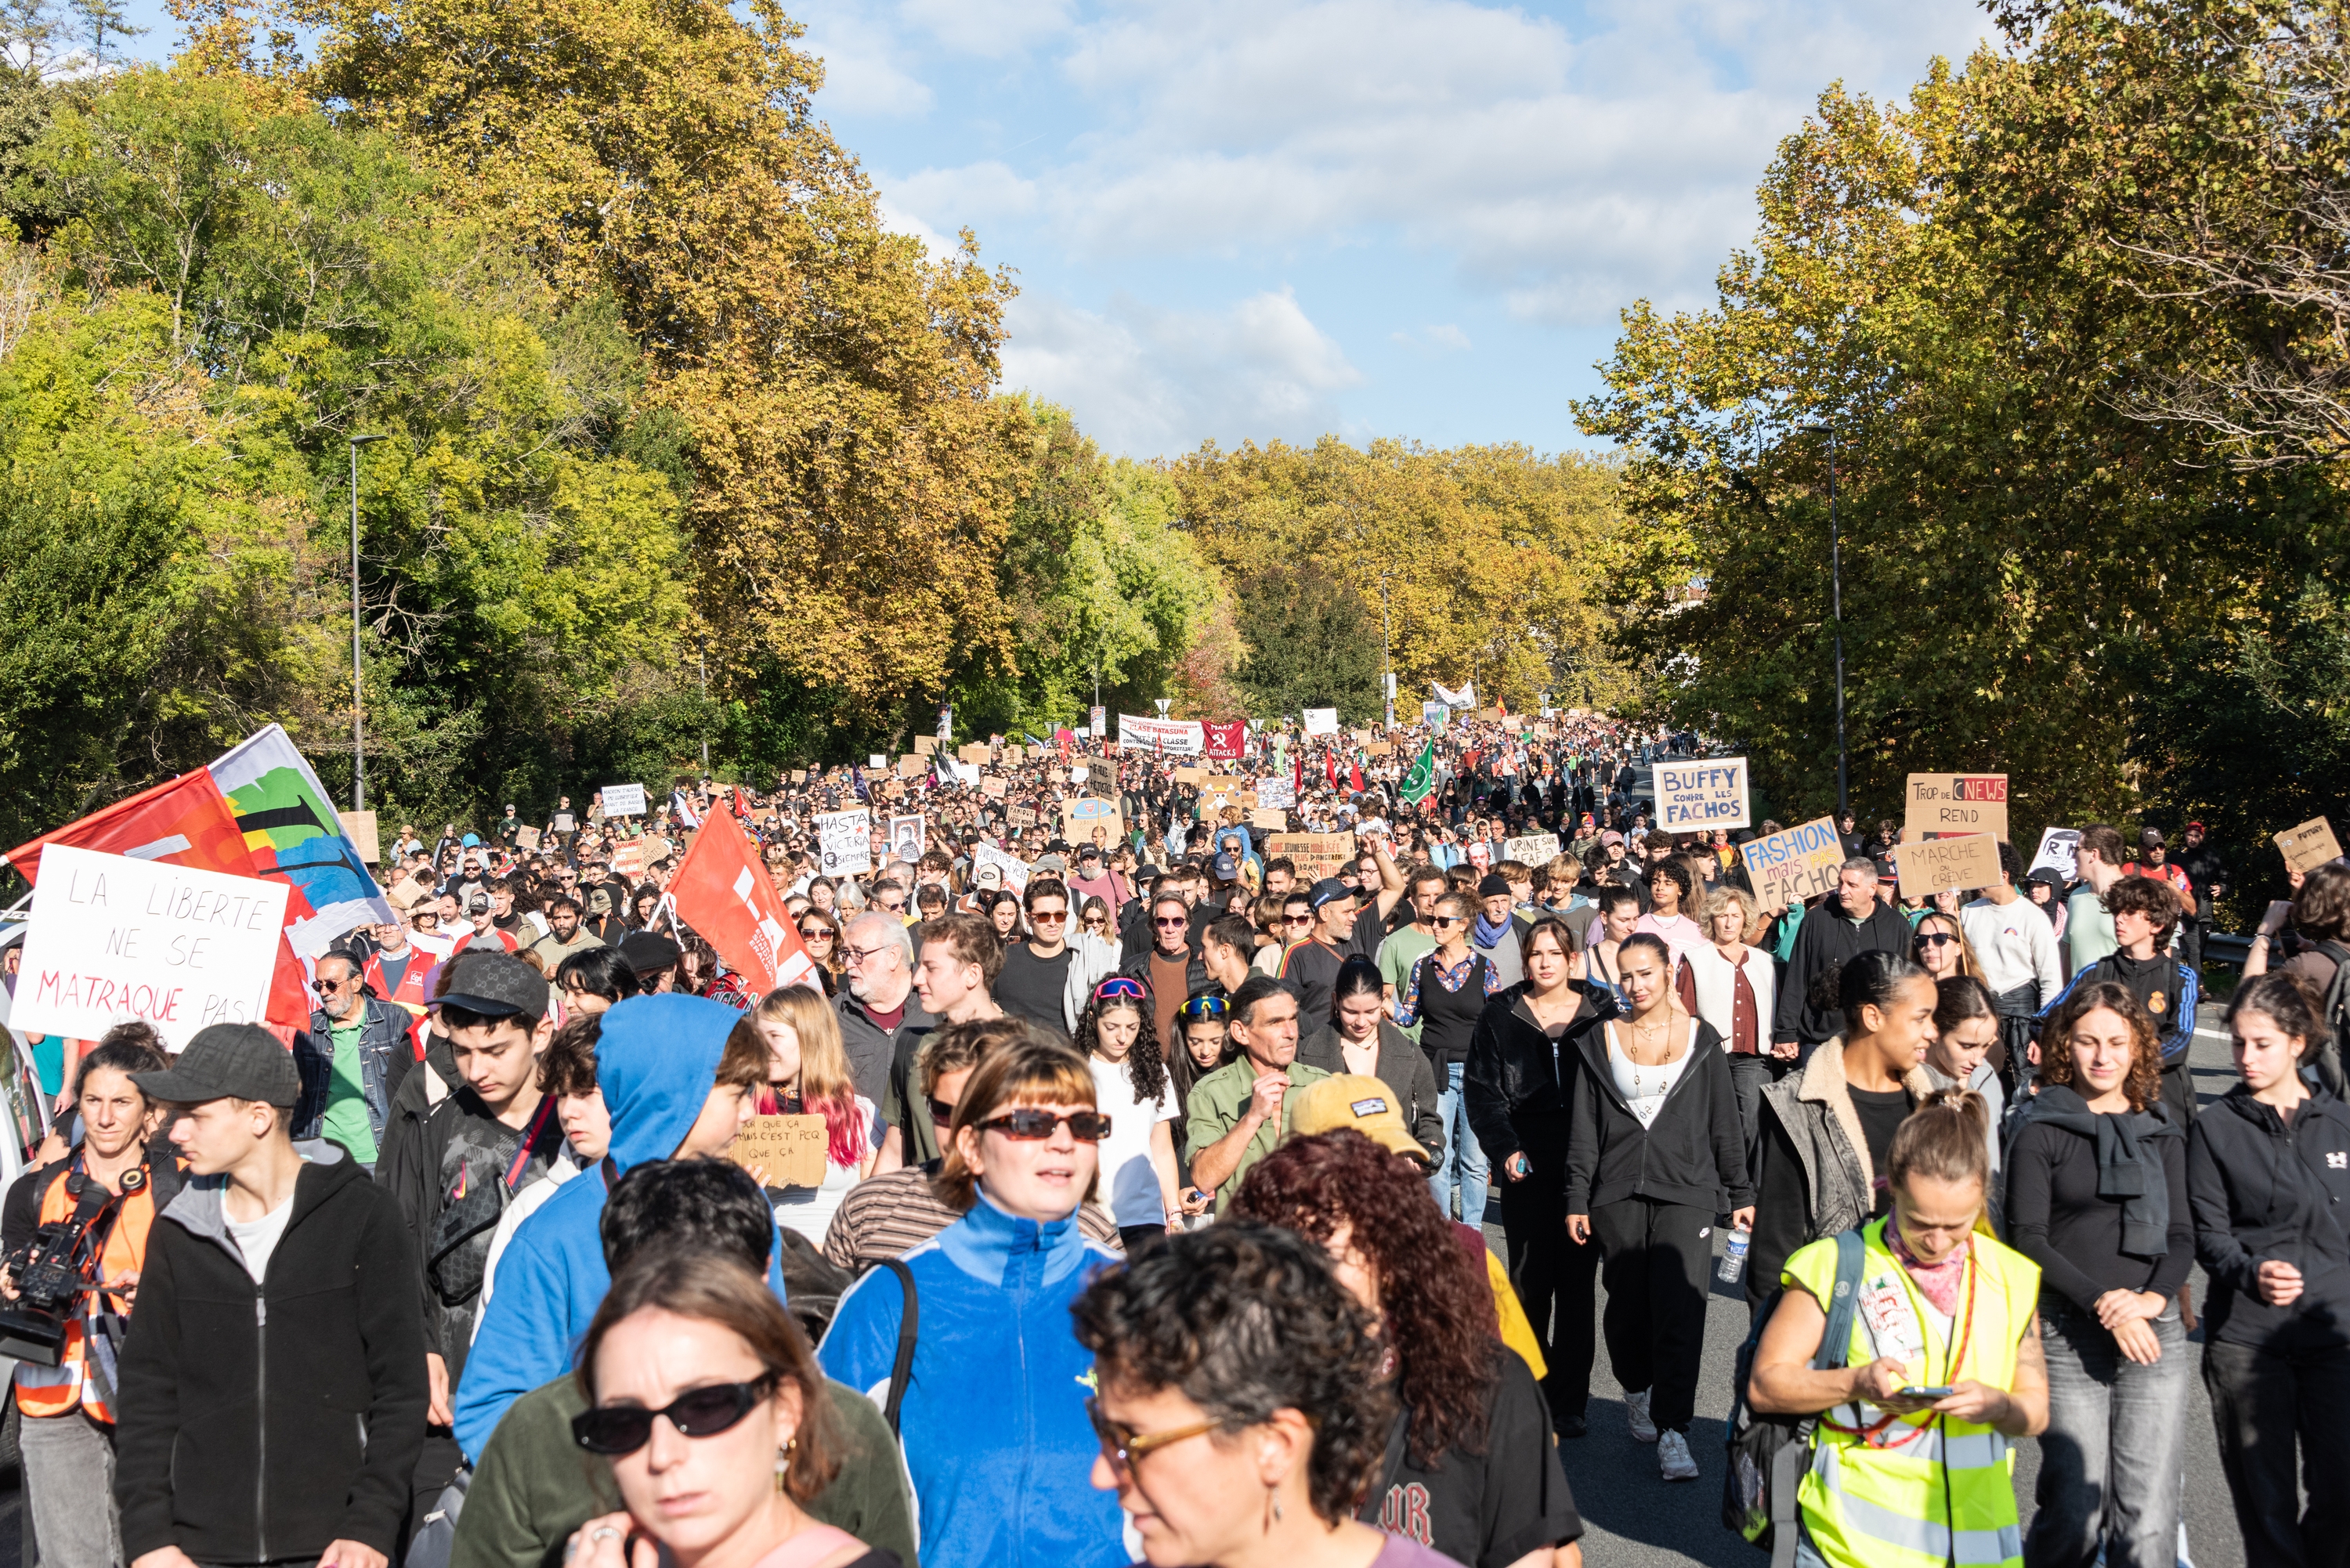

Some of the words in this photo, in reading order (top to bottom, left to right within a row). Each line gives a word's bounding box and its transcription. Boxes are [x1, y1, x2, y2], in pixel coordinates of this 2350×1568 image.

[1152, 726, 1188, 735] BATASUNA
[1209, 748, 1236, 757] ATTACKS
[1663, 768, 1737, 792] BUFFY
[1673, 793, 1705, 802] CONTRE
[1715, 790, 1732, 799] LES
[1913, 782, 1938, 800] TROP
[1954, 780, 2006, 801] CNEWS
[1009, 807, 1035, 818] PANIQUE
[1666, 800, 1741, 823] FACHOS
[1940, 807, 1979, 822] REND
[821, 813, 868, 833] HASTA
[822, 833, 835, 842] LA
[2297, 825, 2323, 841] FUTURE
[615, 840, 643, 849] BALANCEZ
[1270, 842, 1283, 853] UNE
[1283, 843, 1310, 853] JEUNESSE
[1509, 839, 1539, 852] URINE
[1542, 836, 1556, 845] SUR
[1744, 820, 1837, 872] FASHION
[2280, 839, 2293, 848] NO
[998, 851, 1013, 863] PAS
[1014, 860, 1025, 870] AU
[1809, 848, 1838, 870] PAS
[1911, 843, 1980, 866] MARCHE
[1766, 858, 1803, 881] mais
[69, 869, 107, 906] LA
[106, 927, 141, 959] NE
[165, 934, 211, 969] SE
[36, 970, 183, 1021] MATRAQUE
[762, 1120, 782, 1131] QUE
[786, 1120, 800, 1129] ÇA
[760, 1132, 791, 1141] C'EST
[799, 1130, 820, 1141] PCQ
[748, 1147, 771, 1159] QUE
[779, 1147, 794, 1158] ÇA
